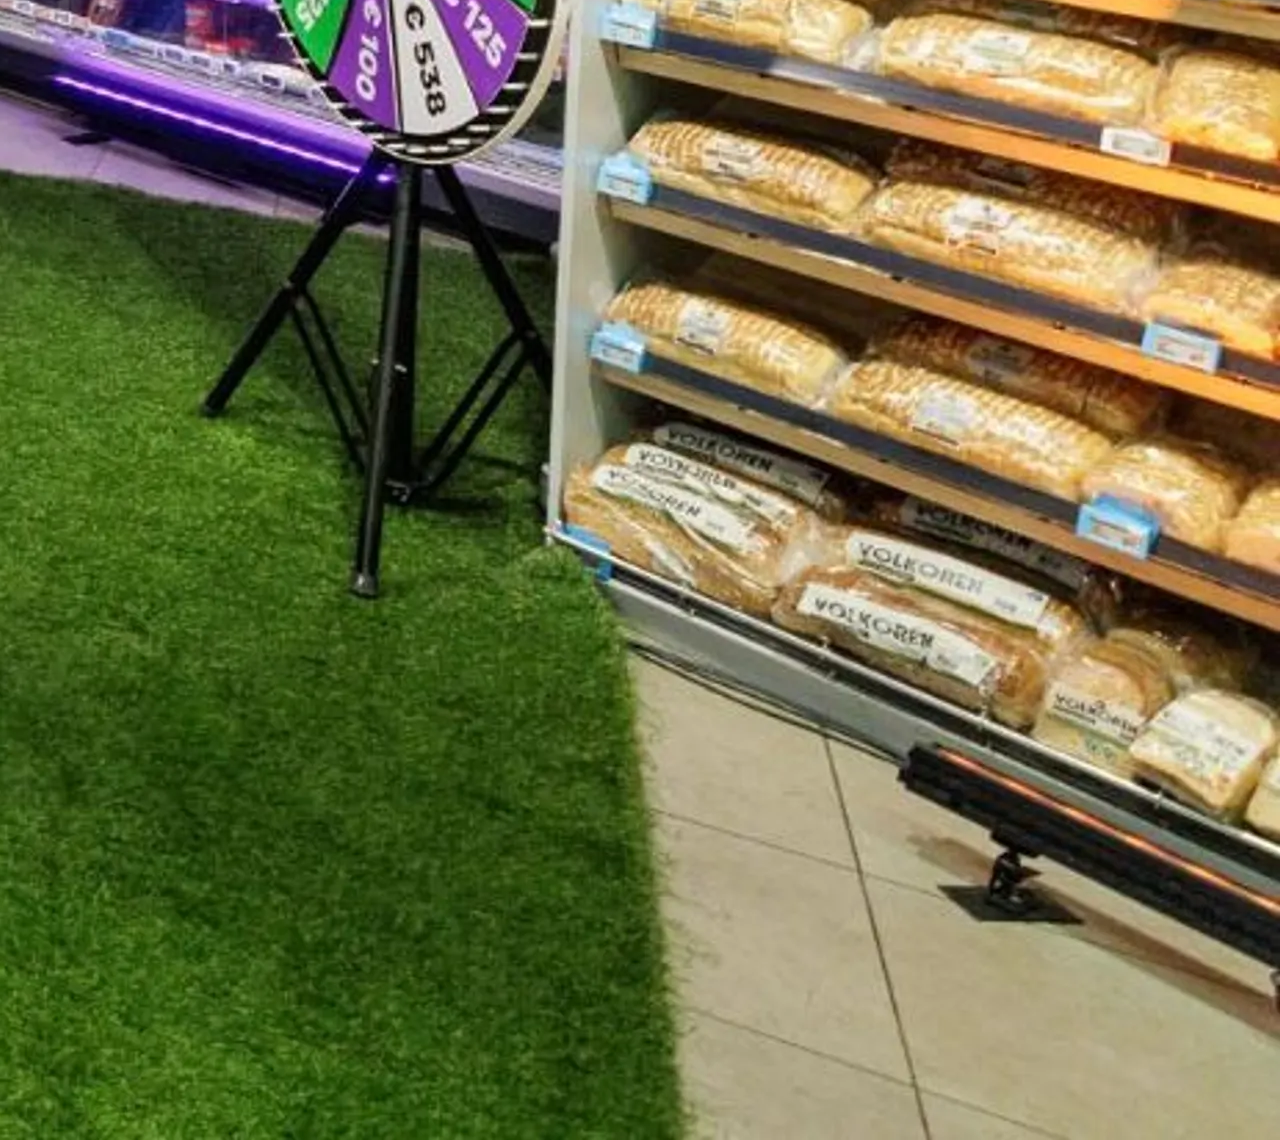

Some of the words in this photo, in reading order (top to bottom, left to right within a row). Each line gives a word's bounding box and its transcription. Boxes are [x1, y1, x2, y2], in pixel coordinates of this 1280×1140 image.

[355, 34, 380, 102] 100
[462, 0, 507, 69] 125
[412, 40, 447, 117] 538
[858, 542, 985, 594] VOLKOREN
[814, 597, 936, 649] VOLKOREN
